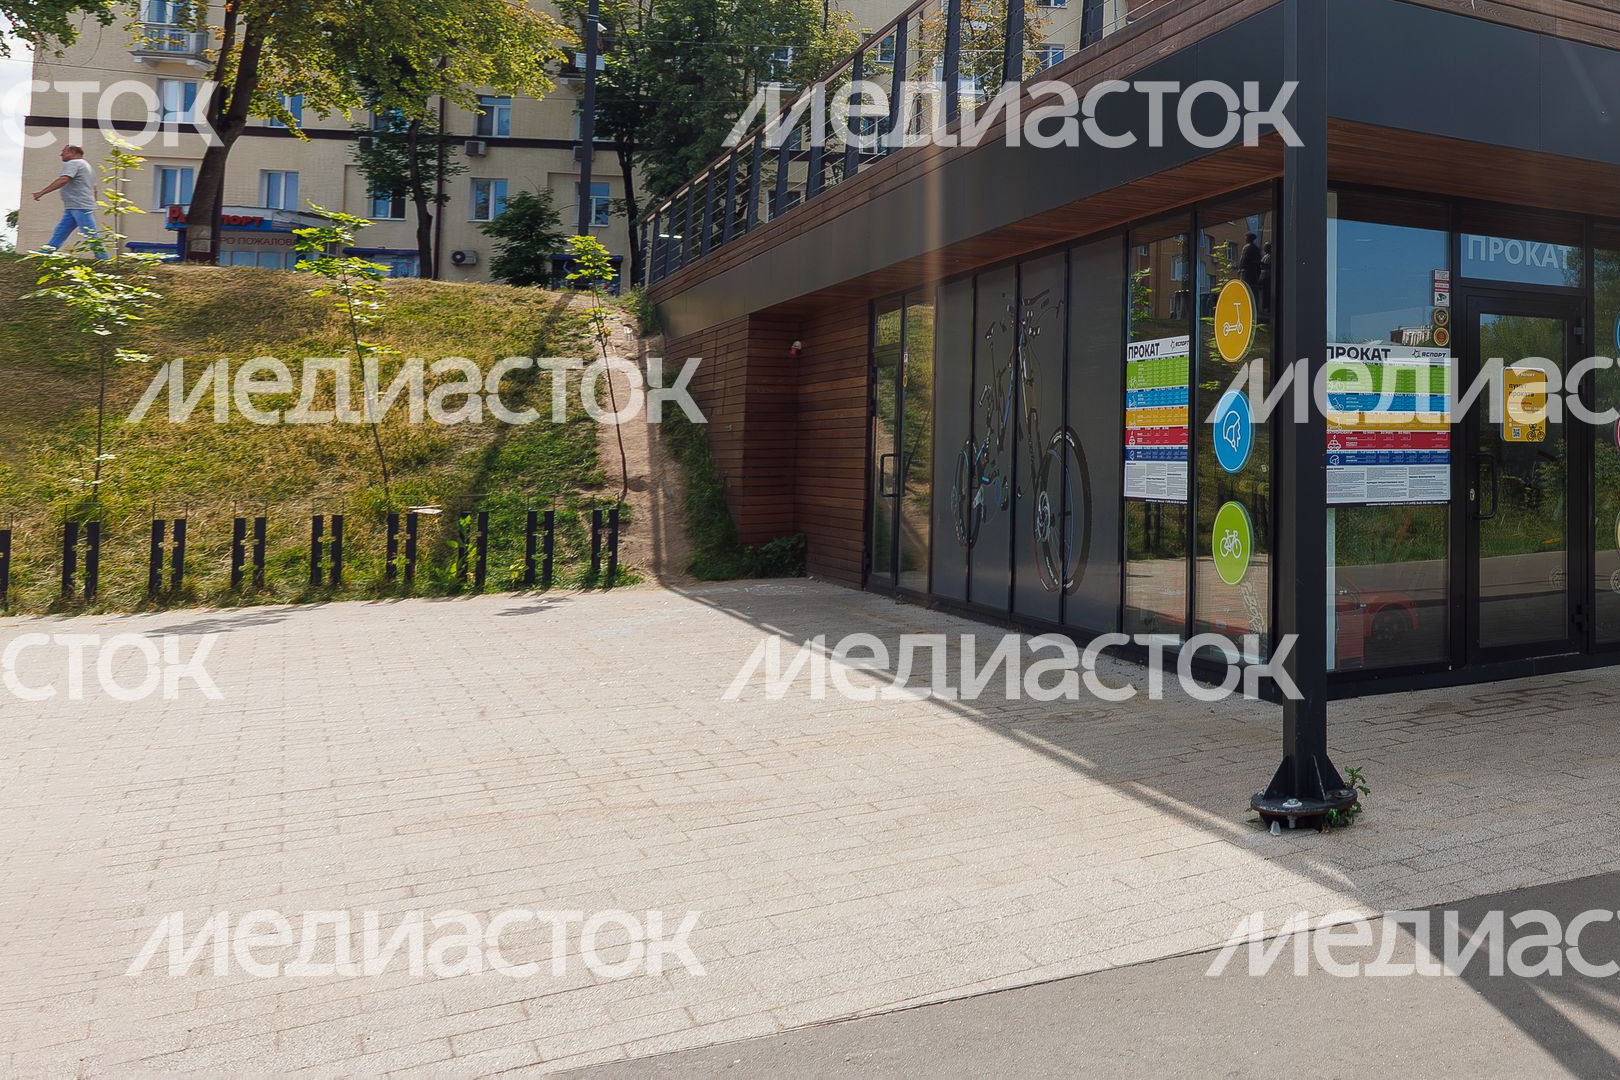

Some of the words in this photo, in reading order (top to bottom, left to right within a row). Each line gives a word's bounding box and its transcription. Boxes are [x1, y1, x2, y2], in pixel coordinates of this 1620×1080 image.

[1468, 235, 1569, 269] ПРОКАТ
[1128, 343, 1160, 359] ПРОКАТ
[1327, 346, 1391, 361] ПРОКАТ
